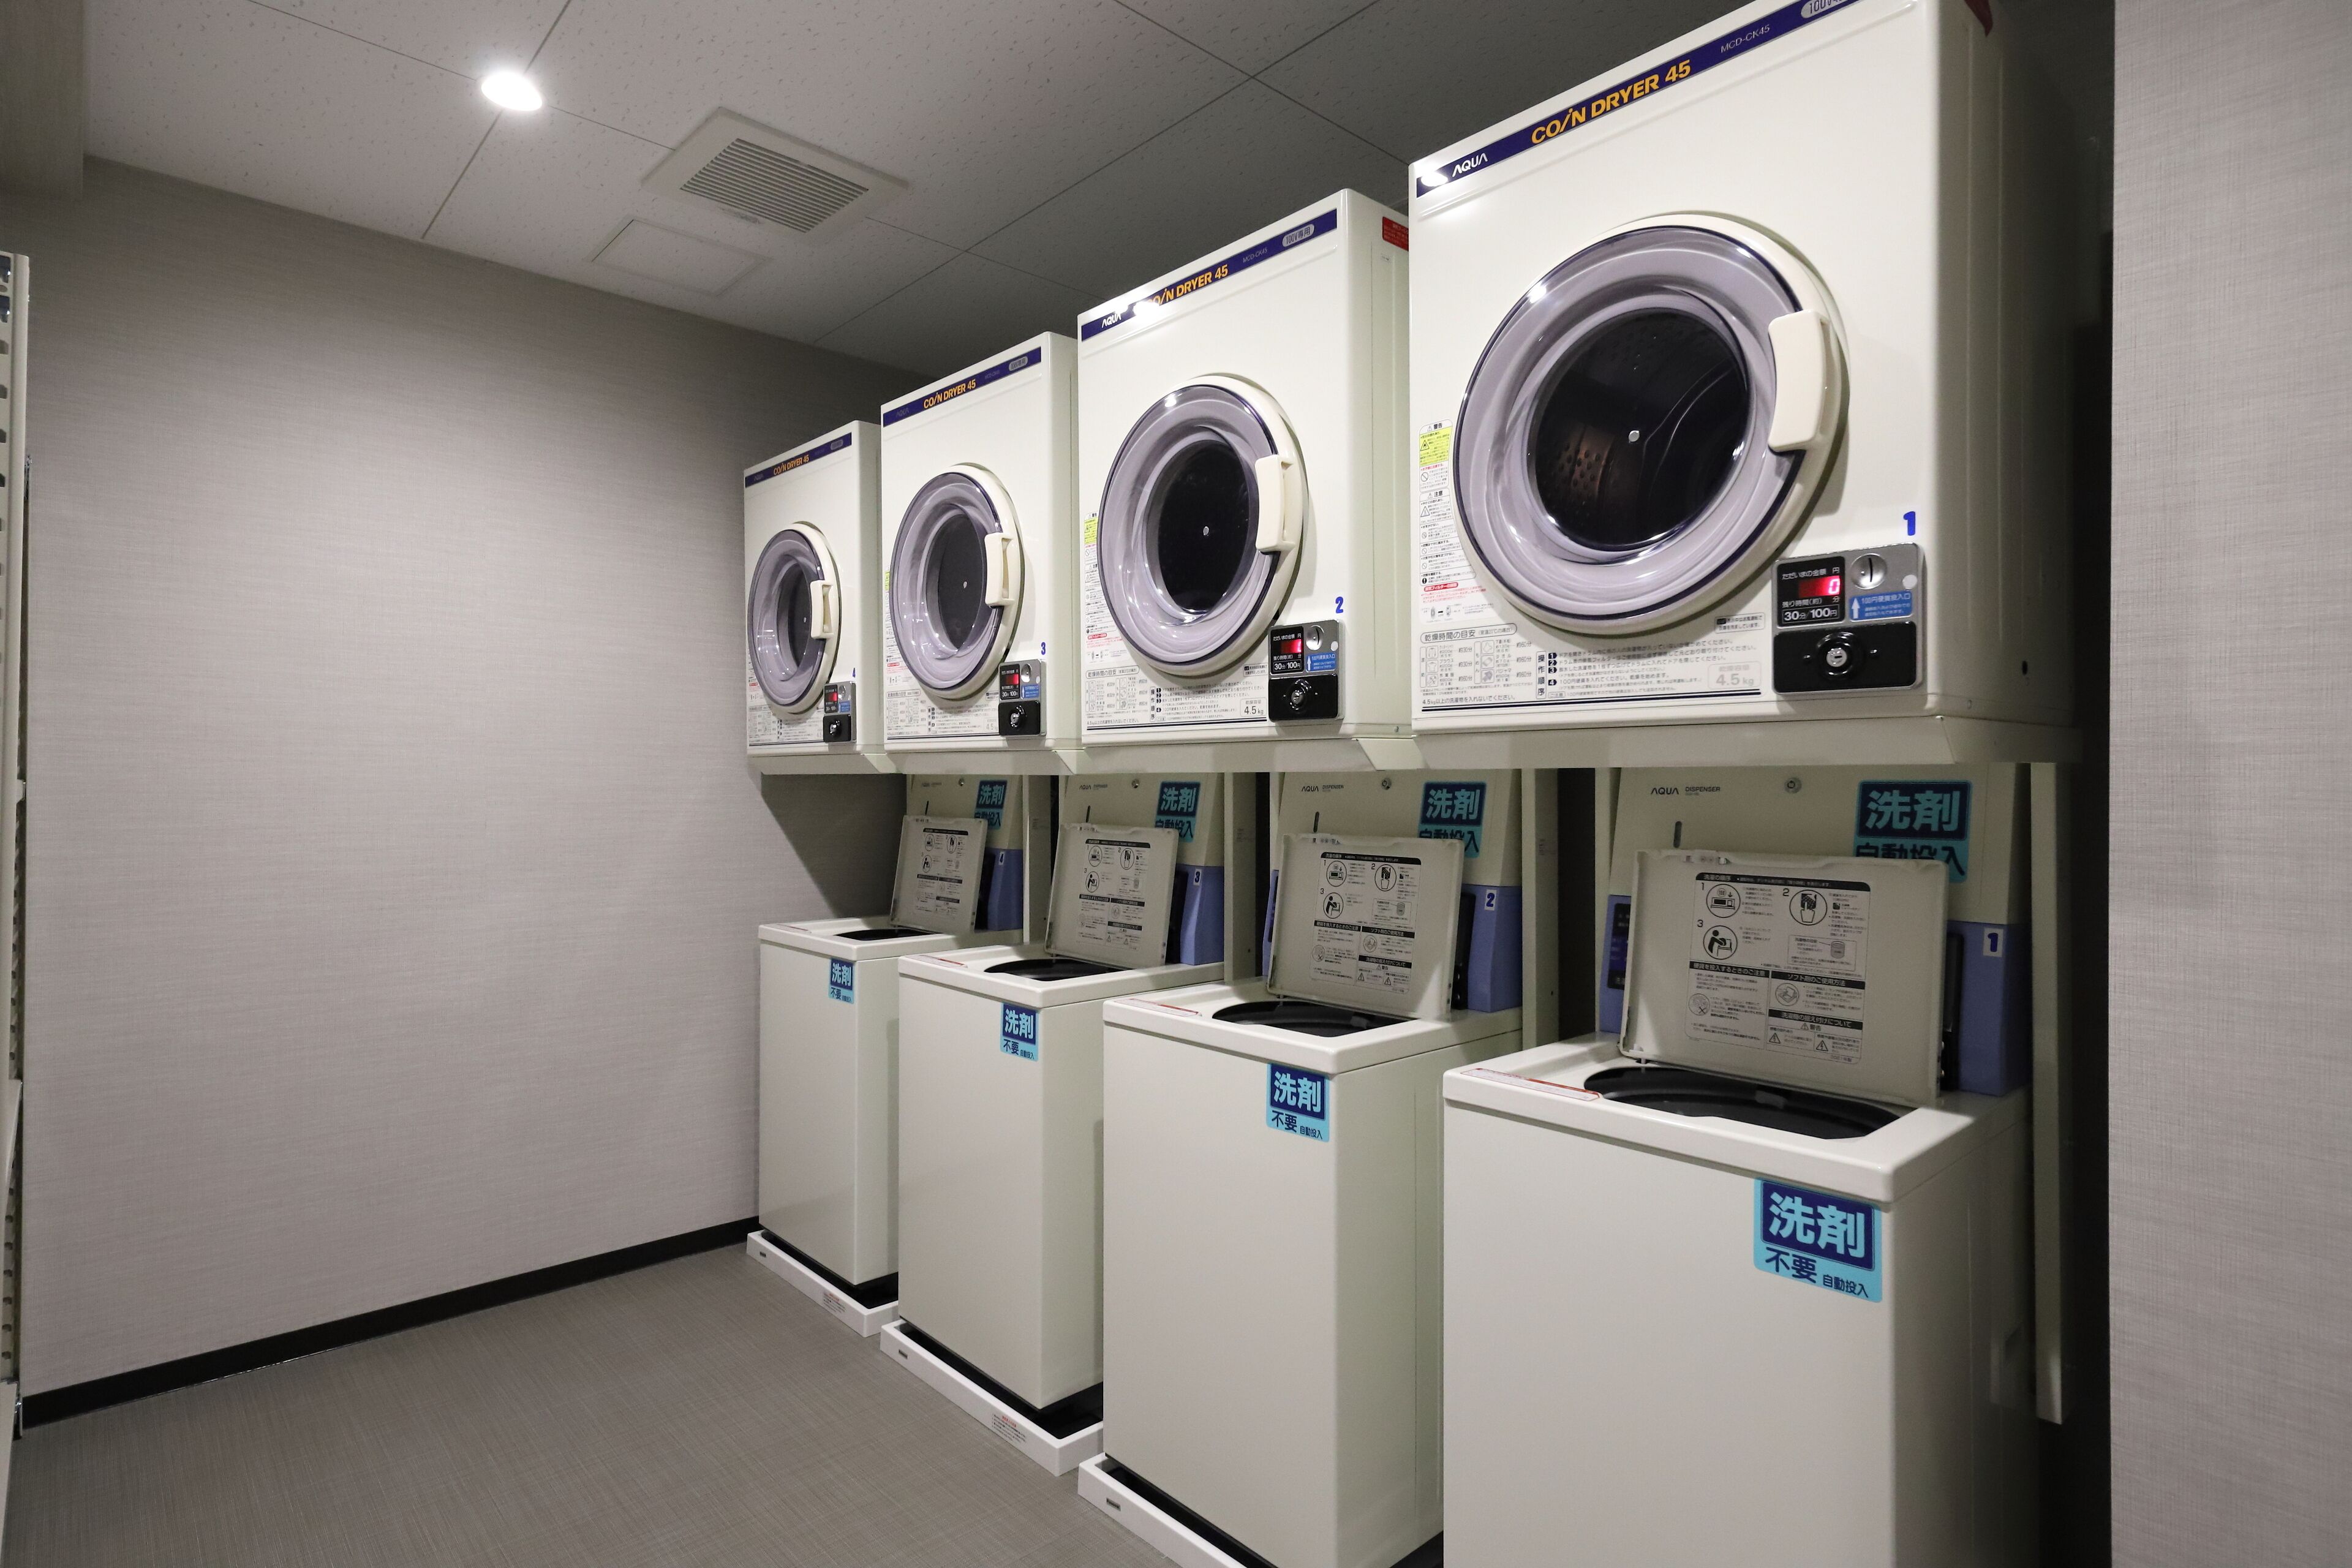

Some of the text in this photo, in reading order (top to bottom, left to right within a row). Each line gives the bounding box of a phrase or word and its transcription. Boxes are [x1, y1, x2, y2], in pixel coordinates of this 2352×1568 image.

[1721, 24, 1770, 53] MCD-CK45
[1590, 74, 1660, 119] DRYER
[1664, 59, 1692, 85] 45
[1452, 152, 1488, 178] AQUA
[1176, 271, 1212, 298] DRYER
[1215, 264, 1228, 280] 45
[944, 384, 966, 401] DRYER
[967, 379, 976, 390] 45
[787, 456, 803, 470] DRYER
[803, 454, 809, 464] 45
[1903, 511, 1916, 536] 1
[1828, 578, 1840, 594] 0
[1335, 597, 1344, 614] 2
[1425, 630, 1476, 642] 乾燥時間の目安
[1041, 642, 1046, 655] 3
[1716, 674, 1754, 686] 4.5 kg
[1244, 706, 1256, 715] 4.5
[979, 785, 1005, 805] 洗剤
[1161, 787, 1197, 812] 洗剤
[1426, 788, 1480, 820] 洗剤
[1866, 790, 1960, 832] 洗剤
[1194, 871, 1200, 883] 3
[1702, 882, 1705, 891] 1
[1487, 892, 1494, 907] 2
[1782, 888, 1789, 897] 2
[1697, 919, 1703, 928] 3
[1988, 932, 1998, 952] 1
[832, 963, 851, 986] 洗剤
[831, 987, 842, 1000] 不要
[1005, 1009, 1033, 1039] 洗剤
[1003, 1039, 1019, 1055] 不要
[1274, 1071, 1321, 1113] 洗剤
[1272, 1110, 1322, 1139] 不要 自動投入
[1769, 1191, 1864, 1258] 洗剤
[1765, 1246, 1868, 1298] 不要 自動投入
